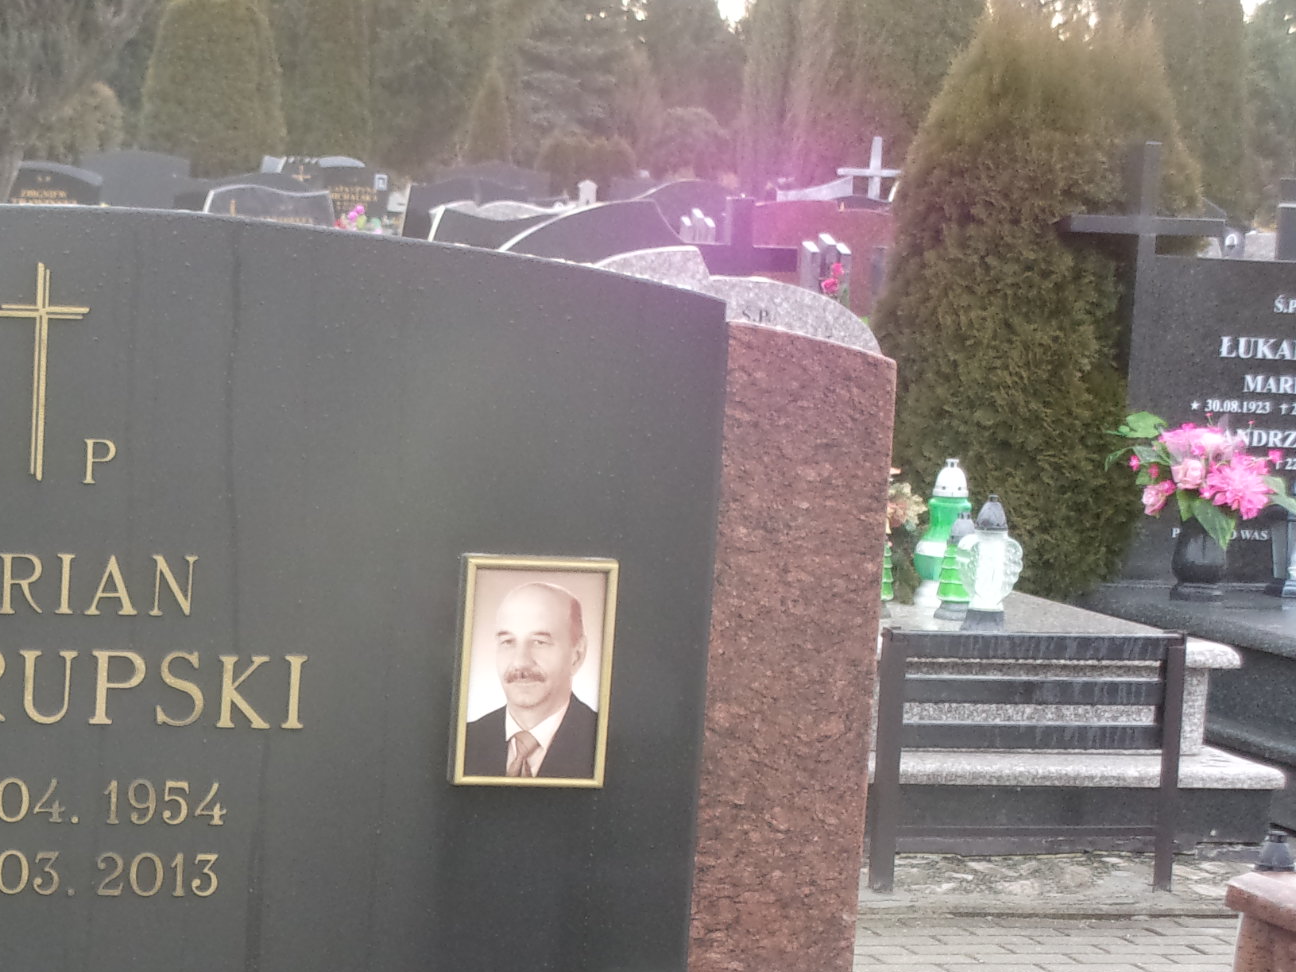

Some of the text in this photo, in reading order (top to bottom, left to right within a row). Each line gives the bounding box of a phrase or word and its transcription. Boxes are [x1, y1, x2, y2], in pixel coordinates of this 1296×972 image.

[1219, 336, 1296, 360] ŁUKA
[1243, 374, 1296, 394] MAR
[1204, 399, 1271, 414] 30.08.1923
[82, 438, 117, 484] P
[1241, 529, 1269, 541] WAS
[103, 779, 227, 826] 1954
[97, 852, 219, 897] 2013
